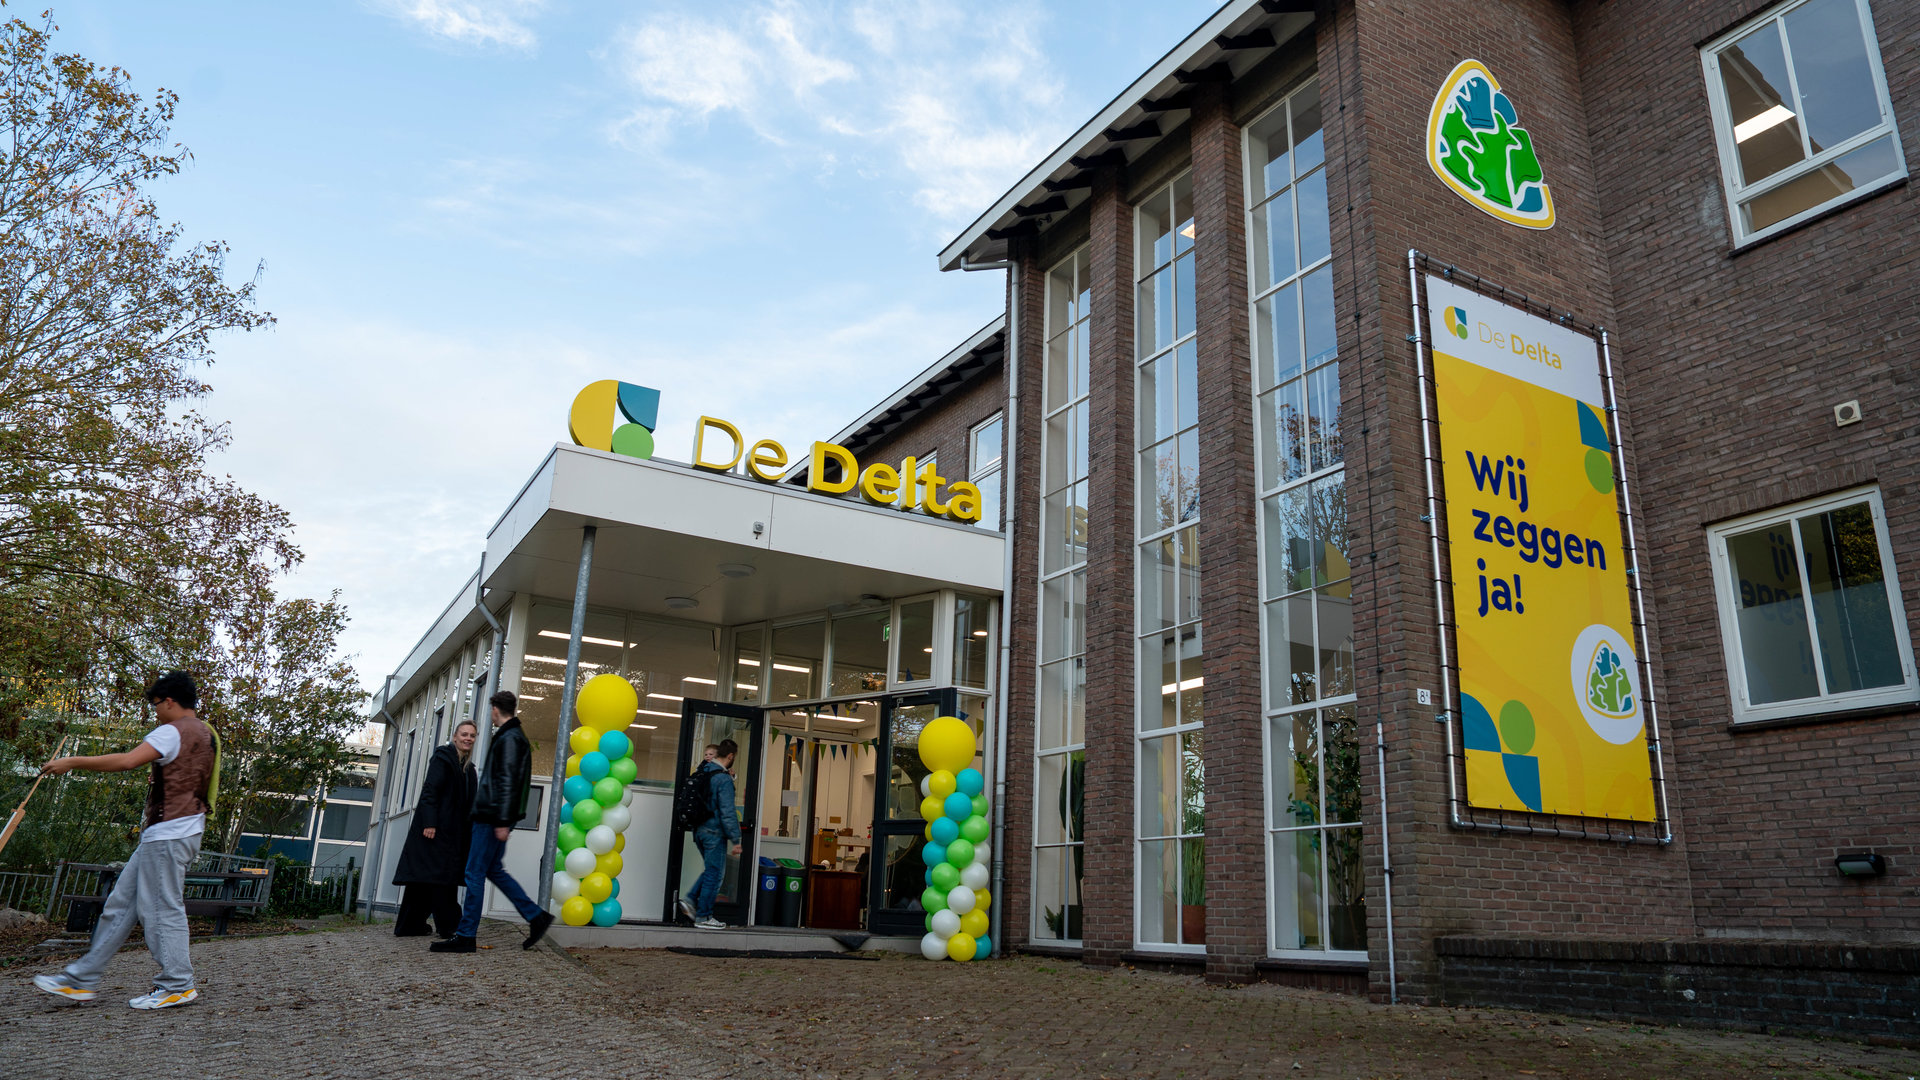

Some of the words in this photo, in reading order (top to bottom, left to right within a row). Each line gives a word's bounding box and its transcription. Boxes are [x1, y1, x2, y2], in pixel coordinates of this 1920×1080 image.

[1478, 321, 1505, 349] De
[1510, 334, 1562, 371] Delta
[691, 415, 788, 484] De
[807, 440, 982, 524] Delta
[1465, 450, 1529, 513] Wij
[1471, 508, 1607, 571] zeggen
[1477, 557, 1525, 617] ja!
